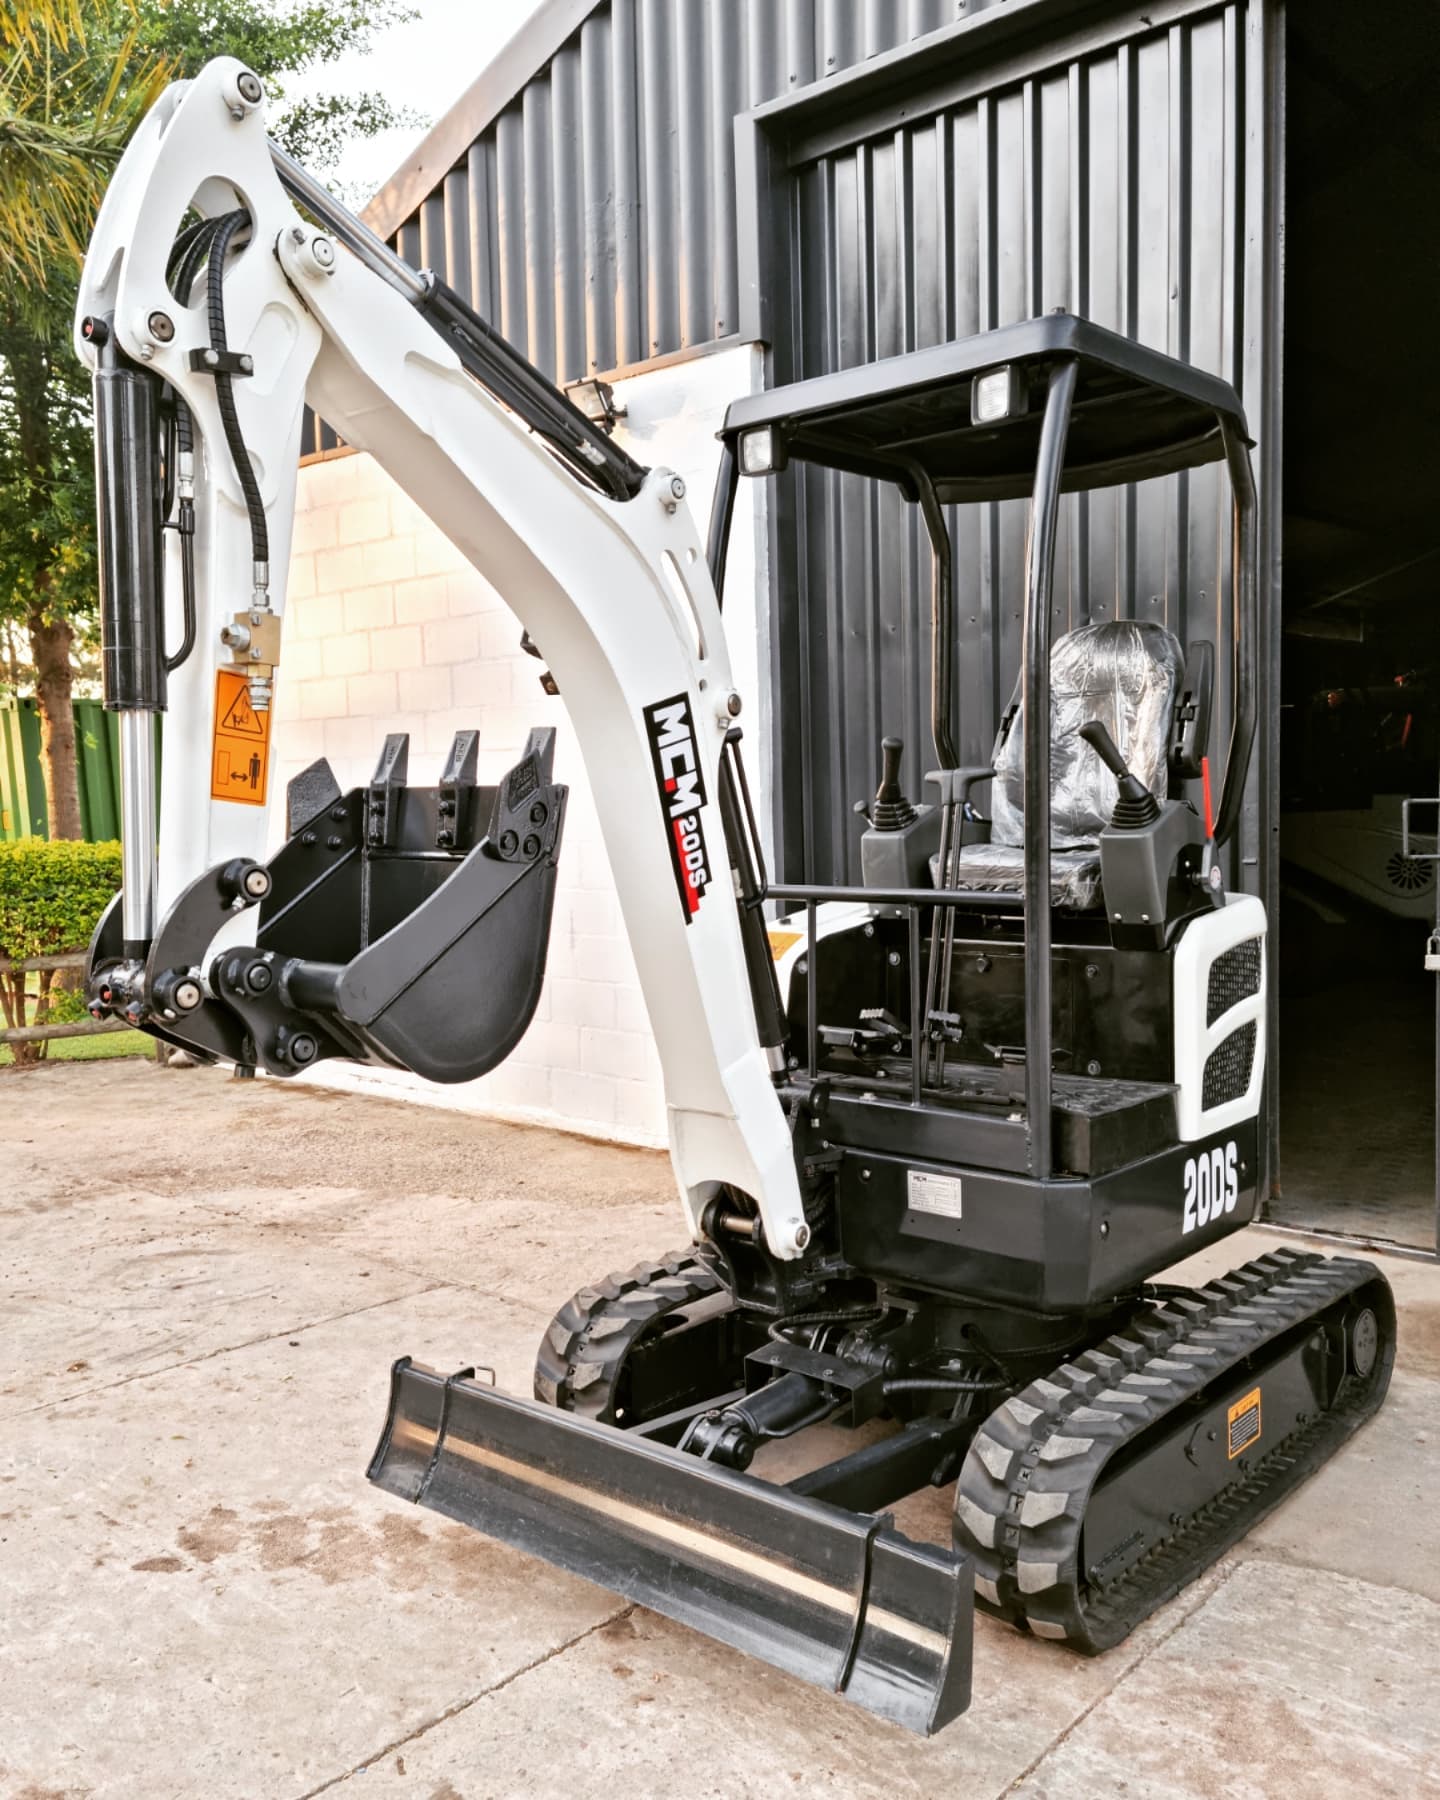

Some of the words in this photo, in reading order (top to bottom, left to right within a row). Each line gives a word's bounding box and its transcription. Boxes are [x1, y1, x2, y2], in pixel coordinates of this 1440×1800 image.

[653, 701, 702, 818] MCM
[679, 815, 707, 889] 20DS
[1182, 1140, 1238, 1236] 20DS
